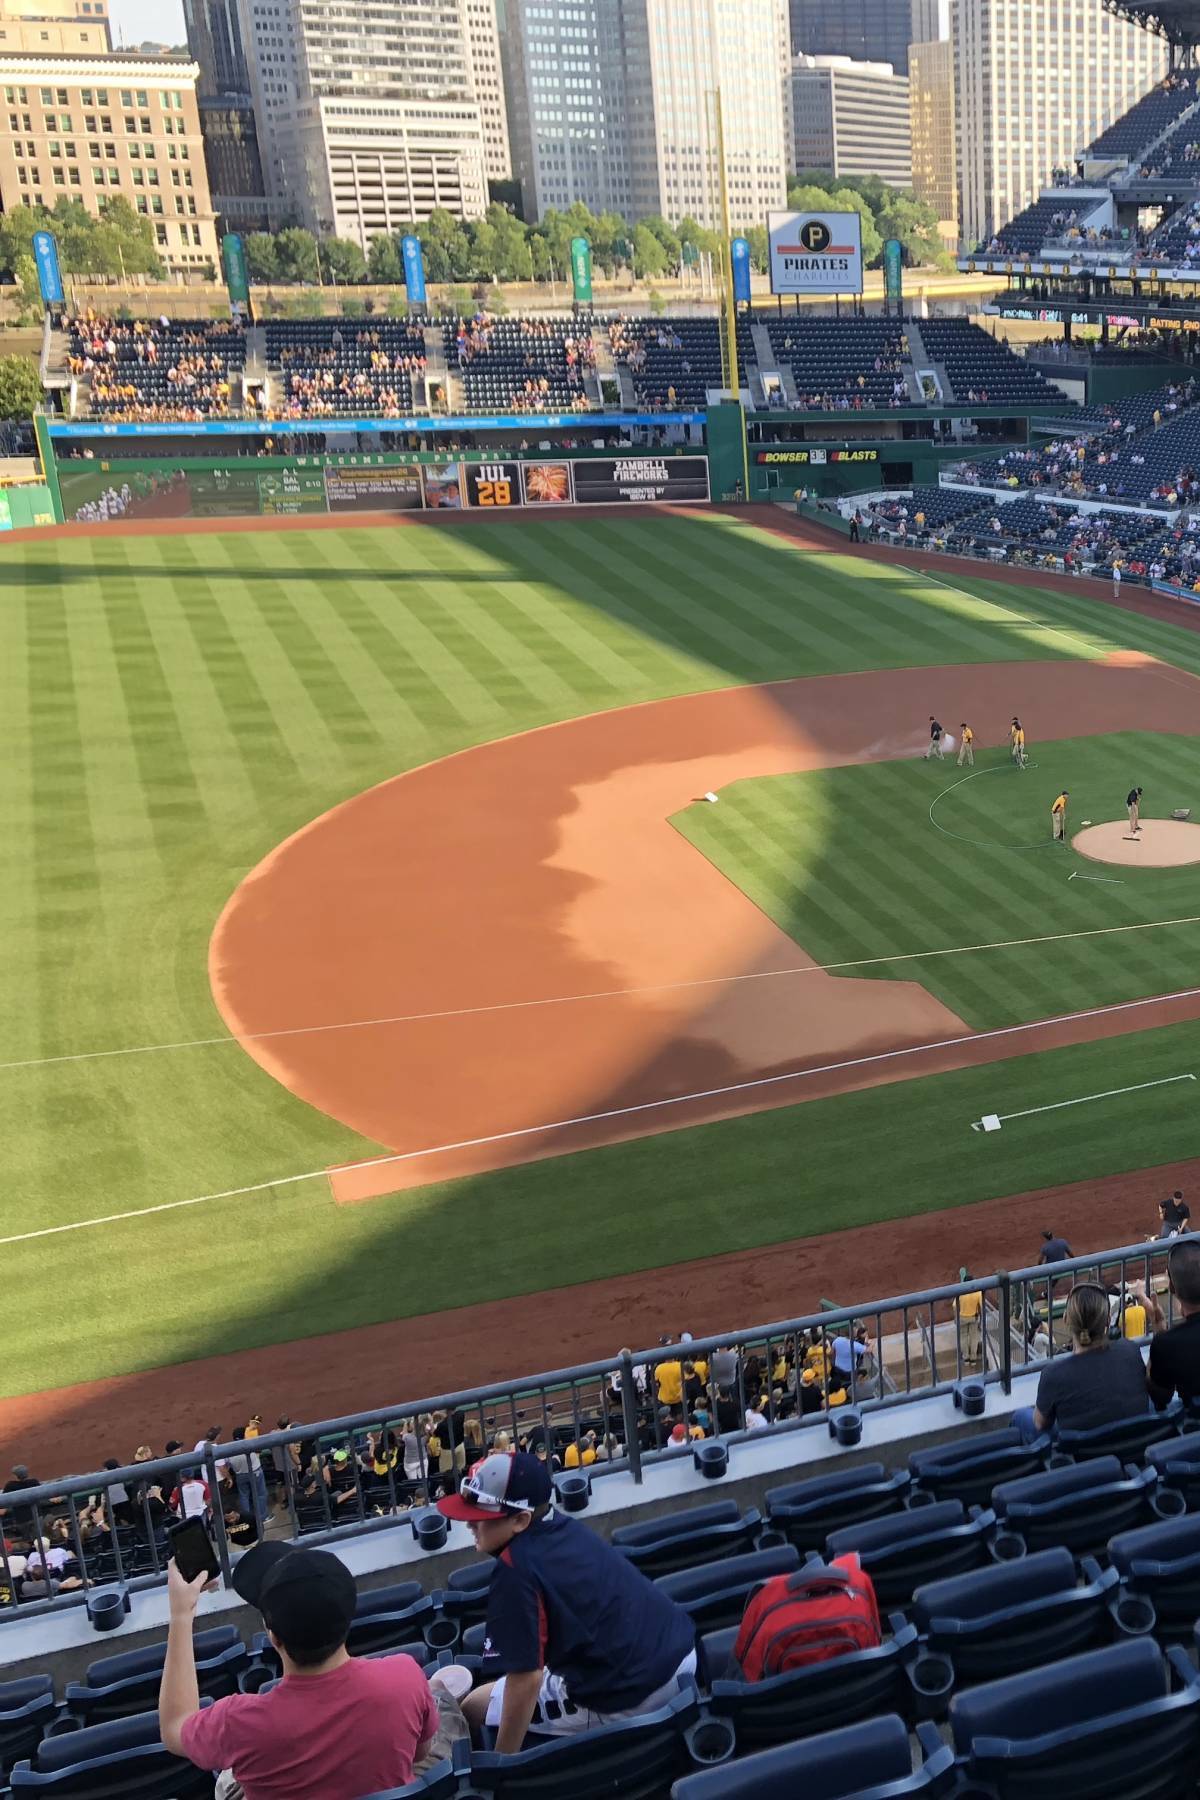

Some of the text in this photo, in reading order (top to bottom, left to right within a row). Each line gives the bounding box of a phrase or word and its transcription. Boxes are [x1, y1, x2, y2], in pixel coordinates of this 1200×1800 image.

[809, 226, 823, 247] P
[784, 258, 848, 270] PIRATES
[785, 271, 849, 281] CHARITIES
[1150, 318, 1200, 330] BATTING 2ND
[297, 453, 524, 466] WELCOME TO PNC PARK
[765, 452, 808, 462] BOWSER
[838, 451, 877, 461] BLASTS
[615, 460, 665, 471] ZAMBELLI
[475, 465, 511, 482] JUL
[613, 470, 669, 481] FIREWORKS
[477, 481, 512, 506] 28
[619, 487, 656, 495] PRESENTED
